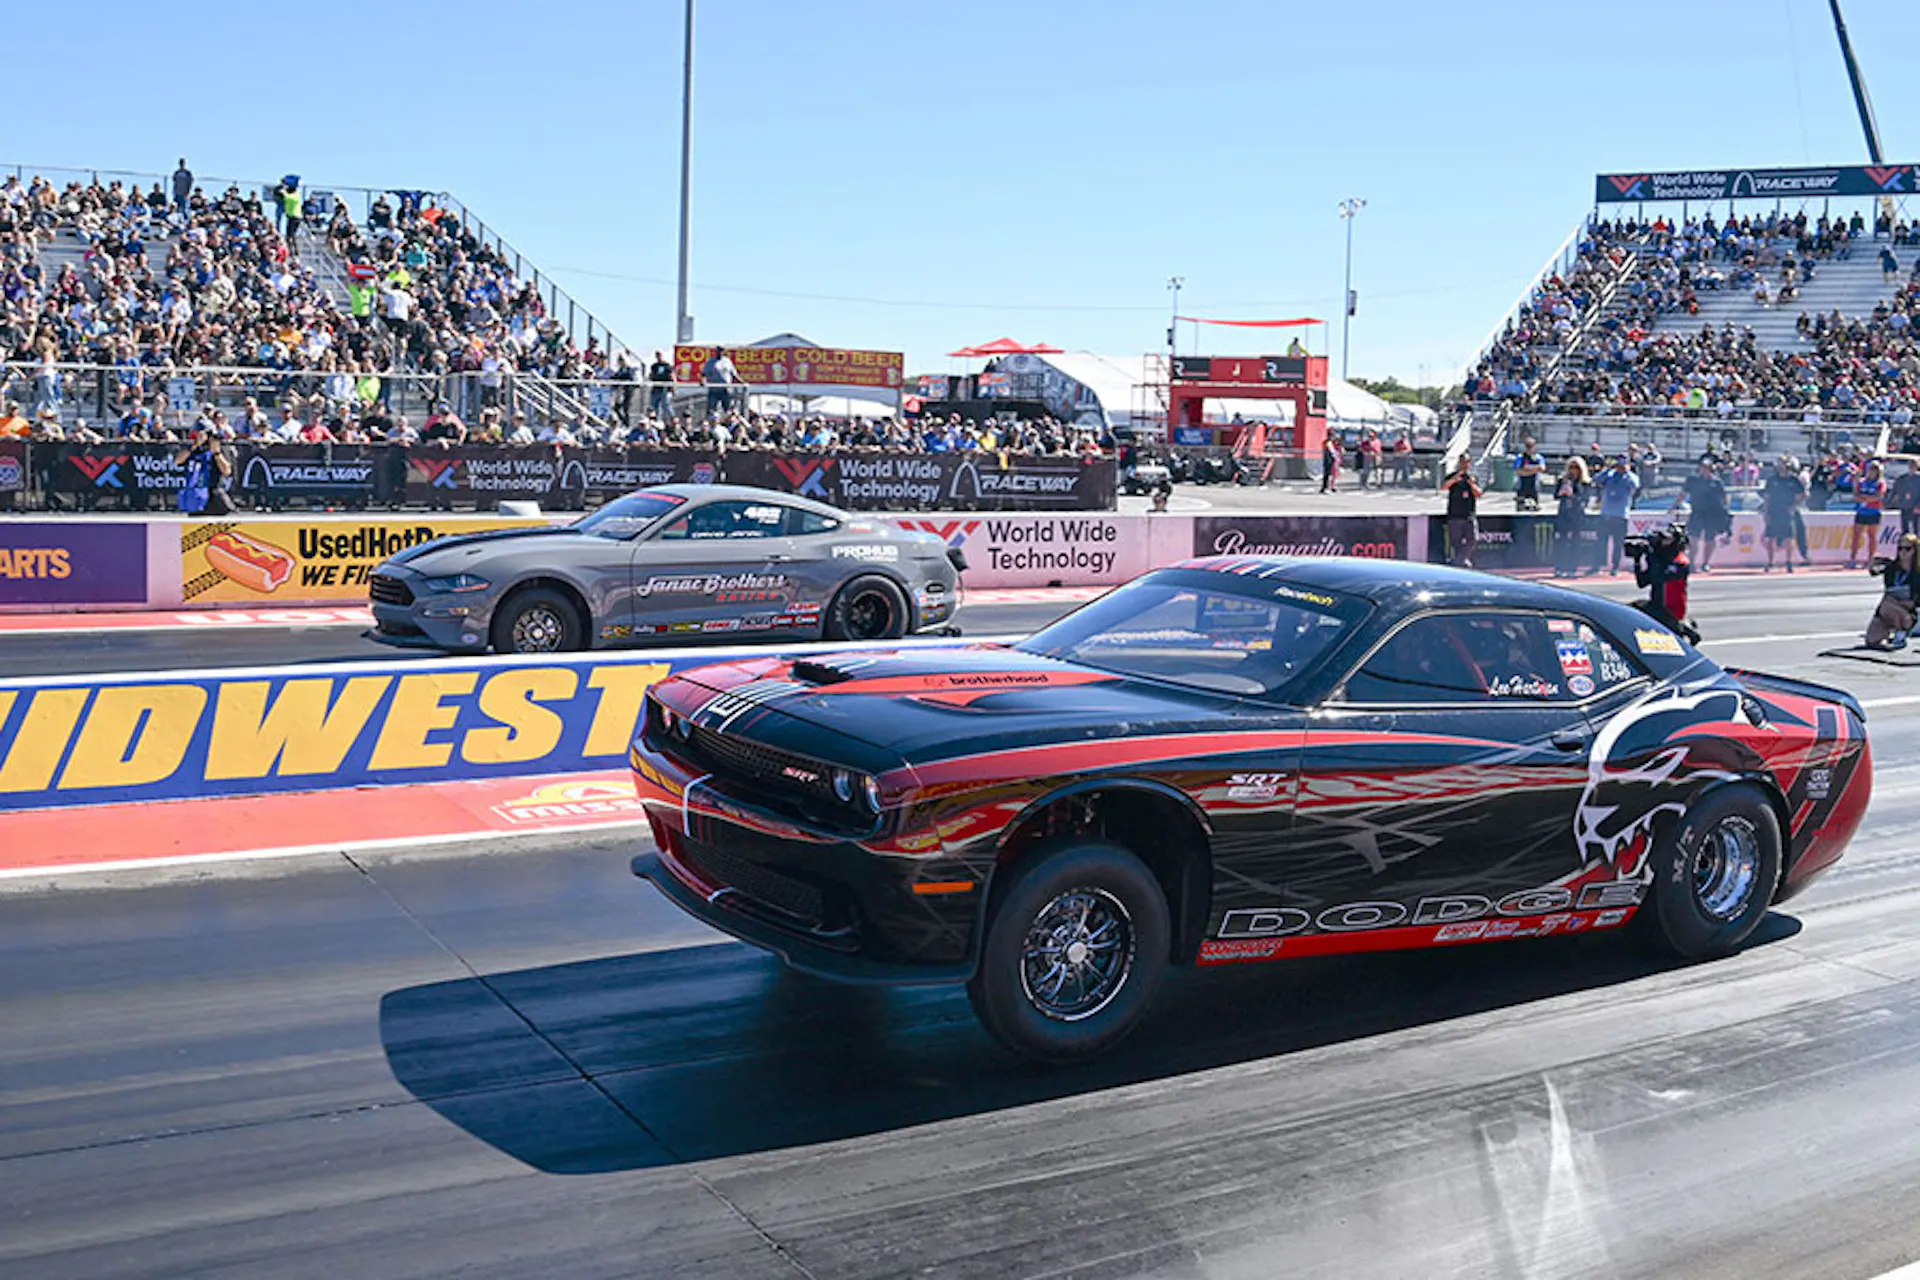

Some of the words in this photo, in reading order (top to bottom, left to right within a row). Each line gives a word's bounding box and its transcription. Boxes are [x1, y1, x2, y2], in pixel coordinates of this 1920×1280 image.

[1652, 174, 1689, 187] World
[1692, 173, 1726, 186] Wide
[1756, 176, 1838, 189] RACEWAY
[1652, 185, 1725, 199] Technology
[736, 349, 786, 363] BEER
[794, 348, 848, 364] COLD
[852, 352, 902, 367] BEER
[272, 466, 372, 480] RACEWAY
[467, 460, 512, 475] World
[515, 460, 553, 475] Wide
[587, 470, 673, 483] RACEWAY
[840, 459, 891, 478] World
[897, 459, 941, 479] Wide
[467, 474, 555, 493] Technology
[840, 479, 940, 502] Technology
[981, 475, 1078, 492] RACEWAY
[987, 520, 1054, 543] World
[1061, 519, 1117, 543] Wide
[0, 548, 71, 579] ARTS
[987, 547, 1116, 573] Technology
[302, 566, 339, 586] WE
[703, 573, 786, 595] Brothers
[949, 676, 1049, 687] brotherhood
[0, 662, 670, 794] IDWEST
[1226, 773, 1289, 789] SRT
[508, 800, 642, 821] miss
[1217, 878, 1645, 939] DODGE
